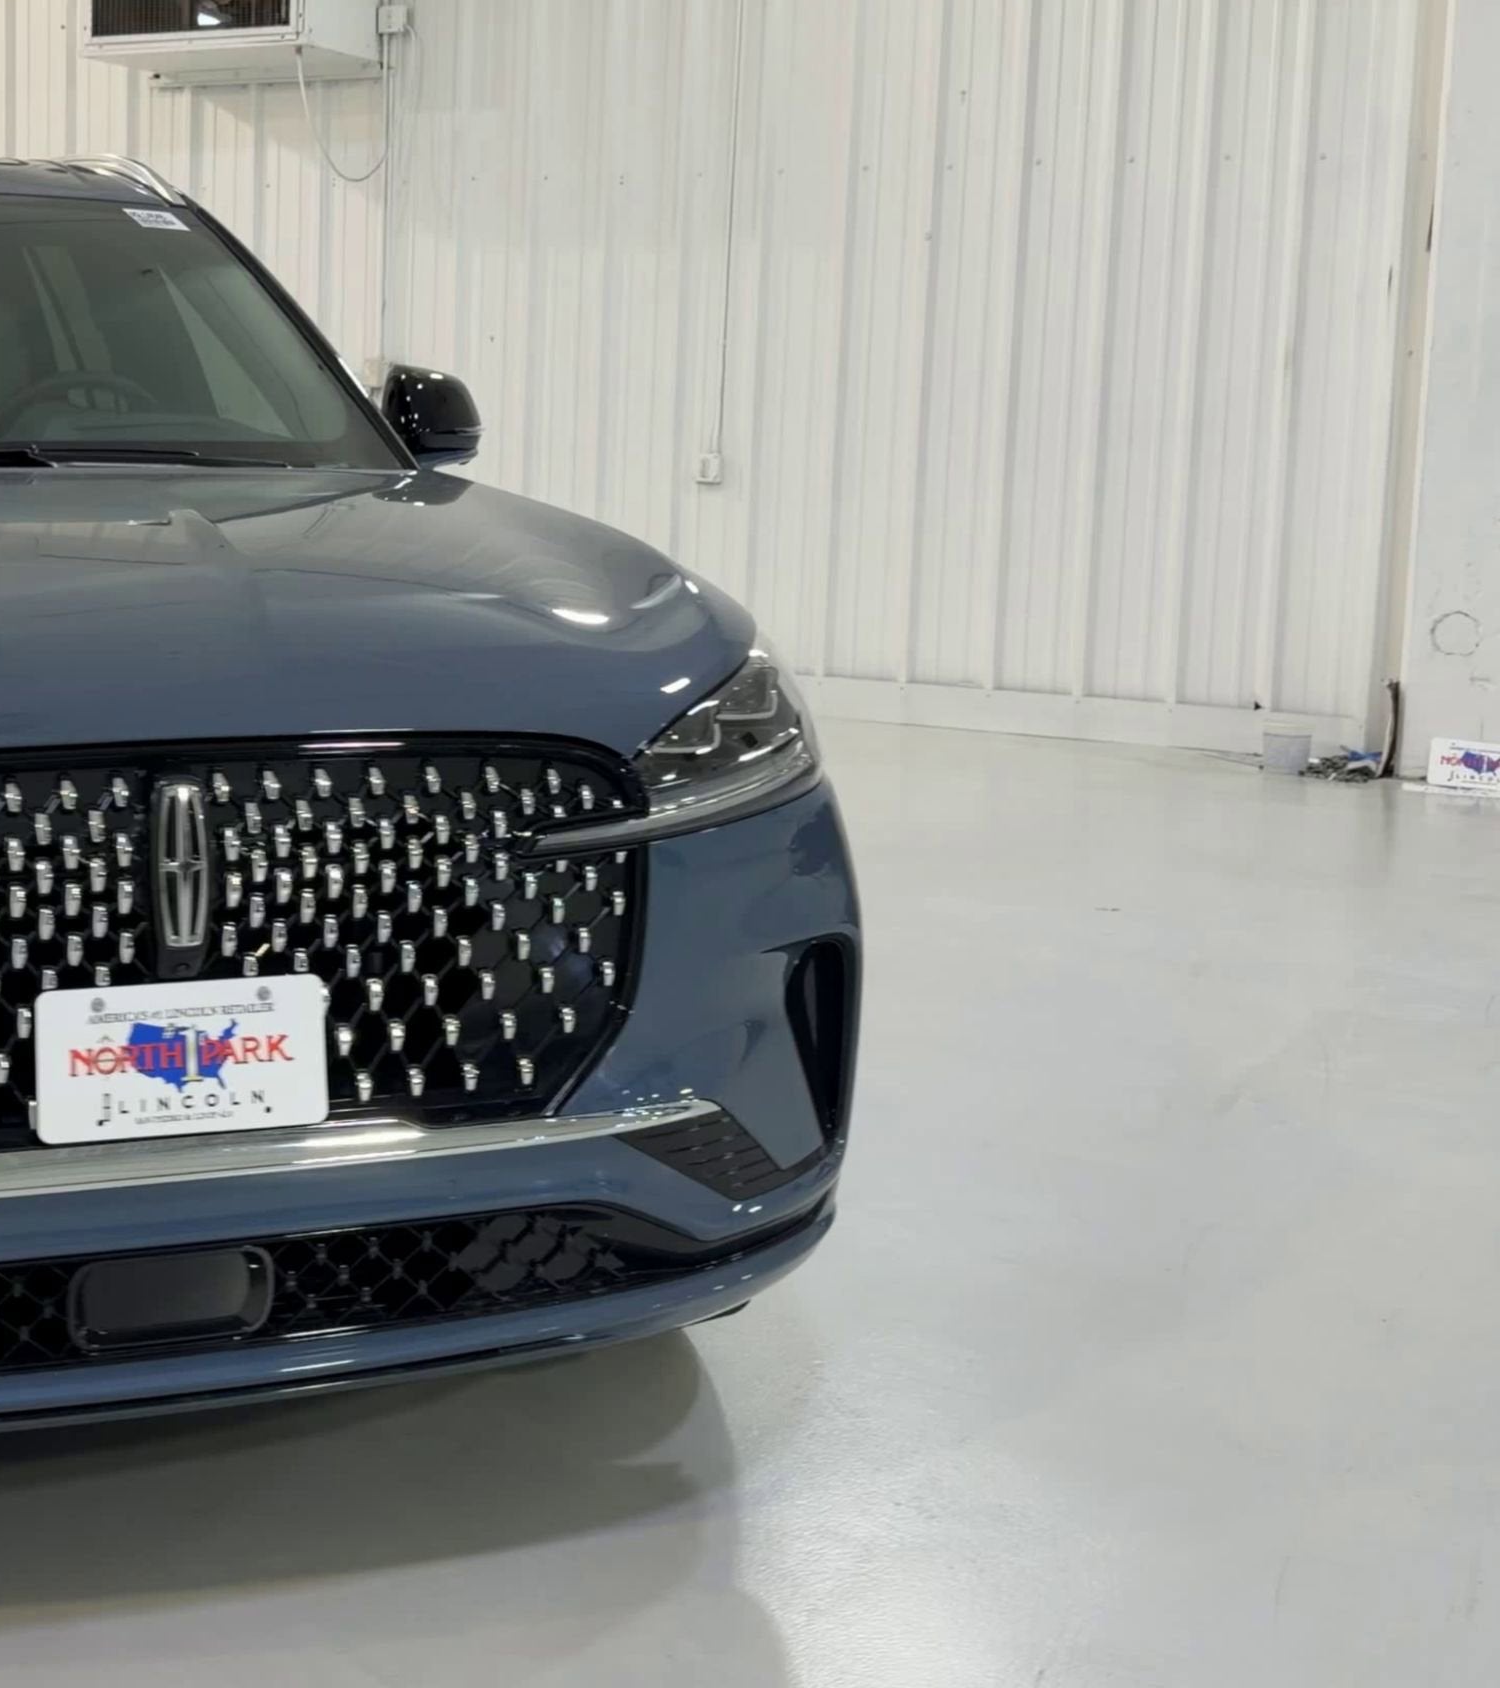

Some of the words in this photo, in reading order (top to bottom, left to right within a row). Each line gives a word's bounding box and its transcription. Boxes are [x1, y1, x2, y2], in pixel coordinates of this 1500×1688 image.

[69, 1045, 186, 1077] NORTH
[201, 1034, 294, 1066] PARK
[118, 1090, 265, 1114] LINCOLN
